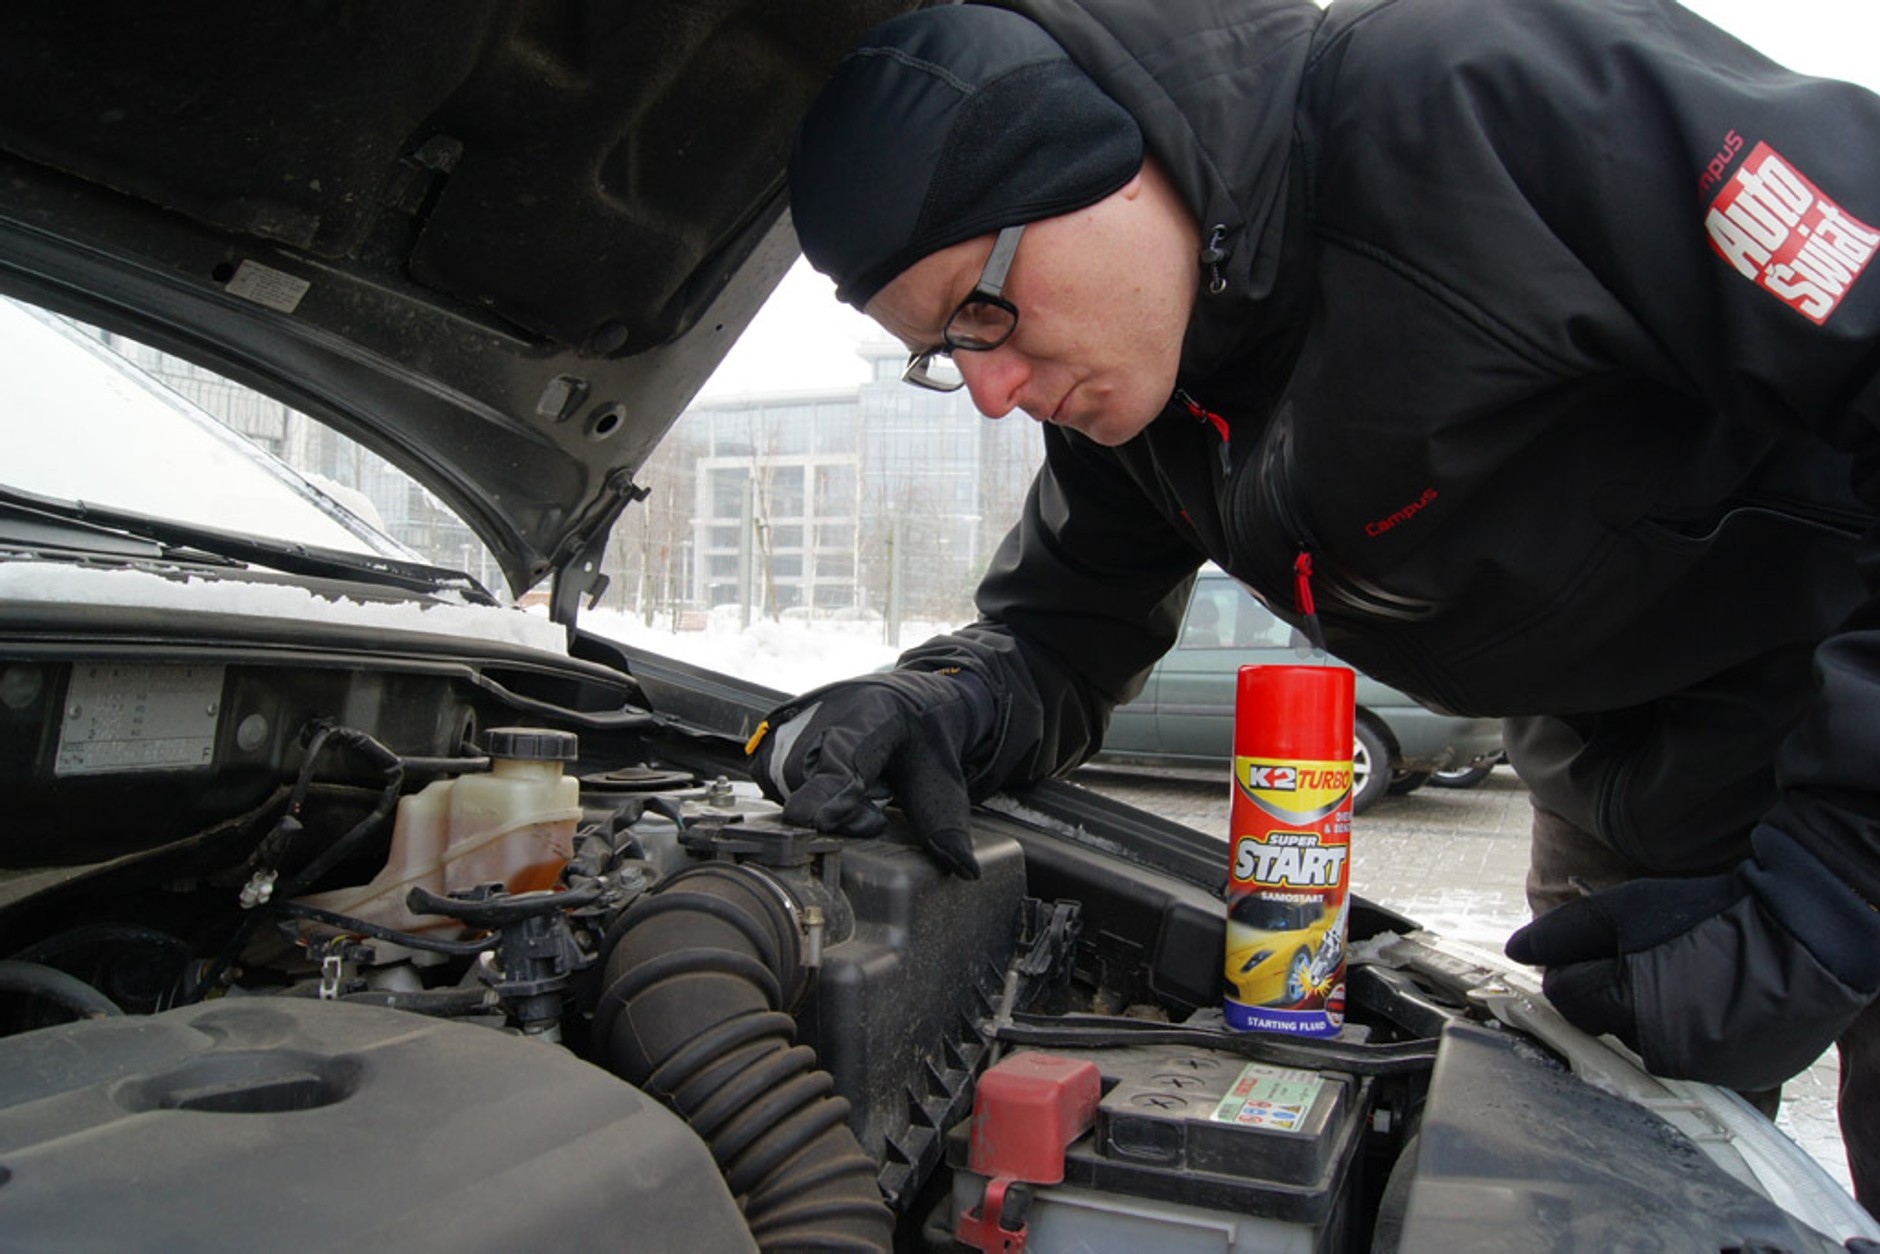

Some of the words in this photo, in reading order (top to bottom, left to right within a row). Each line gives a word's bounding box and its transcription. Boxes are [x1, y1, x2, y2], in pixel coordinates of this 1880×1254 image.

[1705, 154, 1814, 280] Auto
[1251, 766, 1296, 790] K2
[1298, 770, 1350, 789] TURBO
[1269, 834, 1318, 846] SUPER
[1235, 840, 1347, 884] START
[1261, 891, 1324, 903] SAMOSTART
[1247, 1016, 1297, 1031] STARTING
[1300, 1021, 1326, 1031] FLUID
